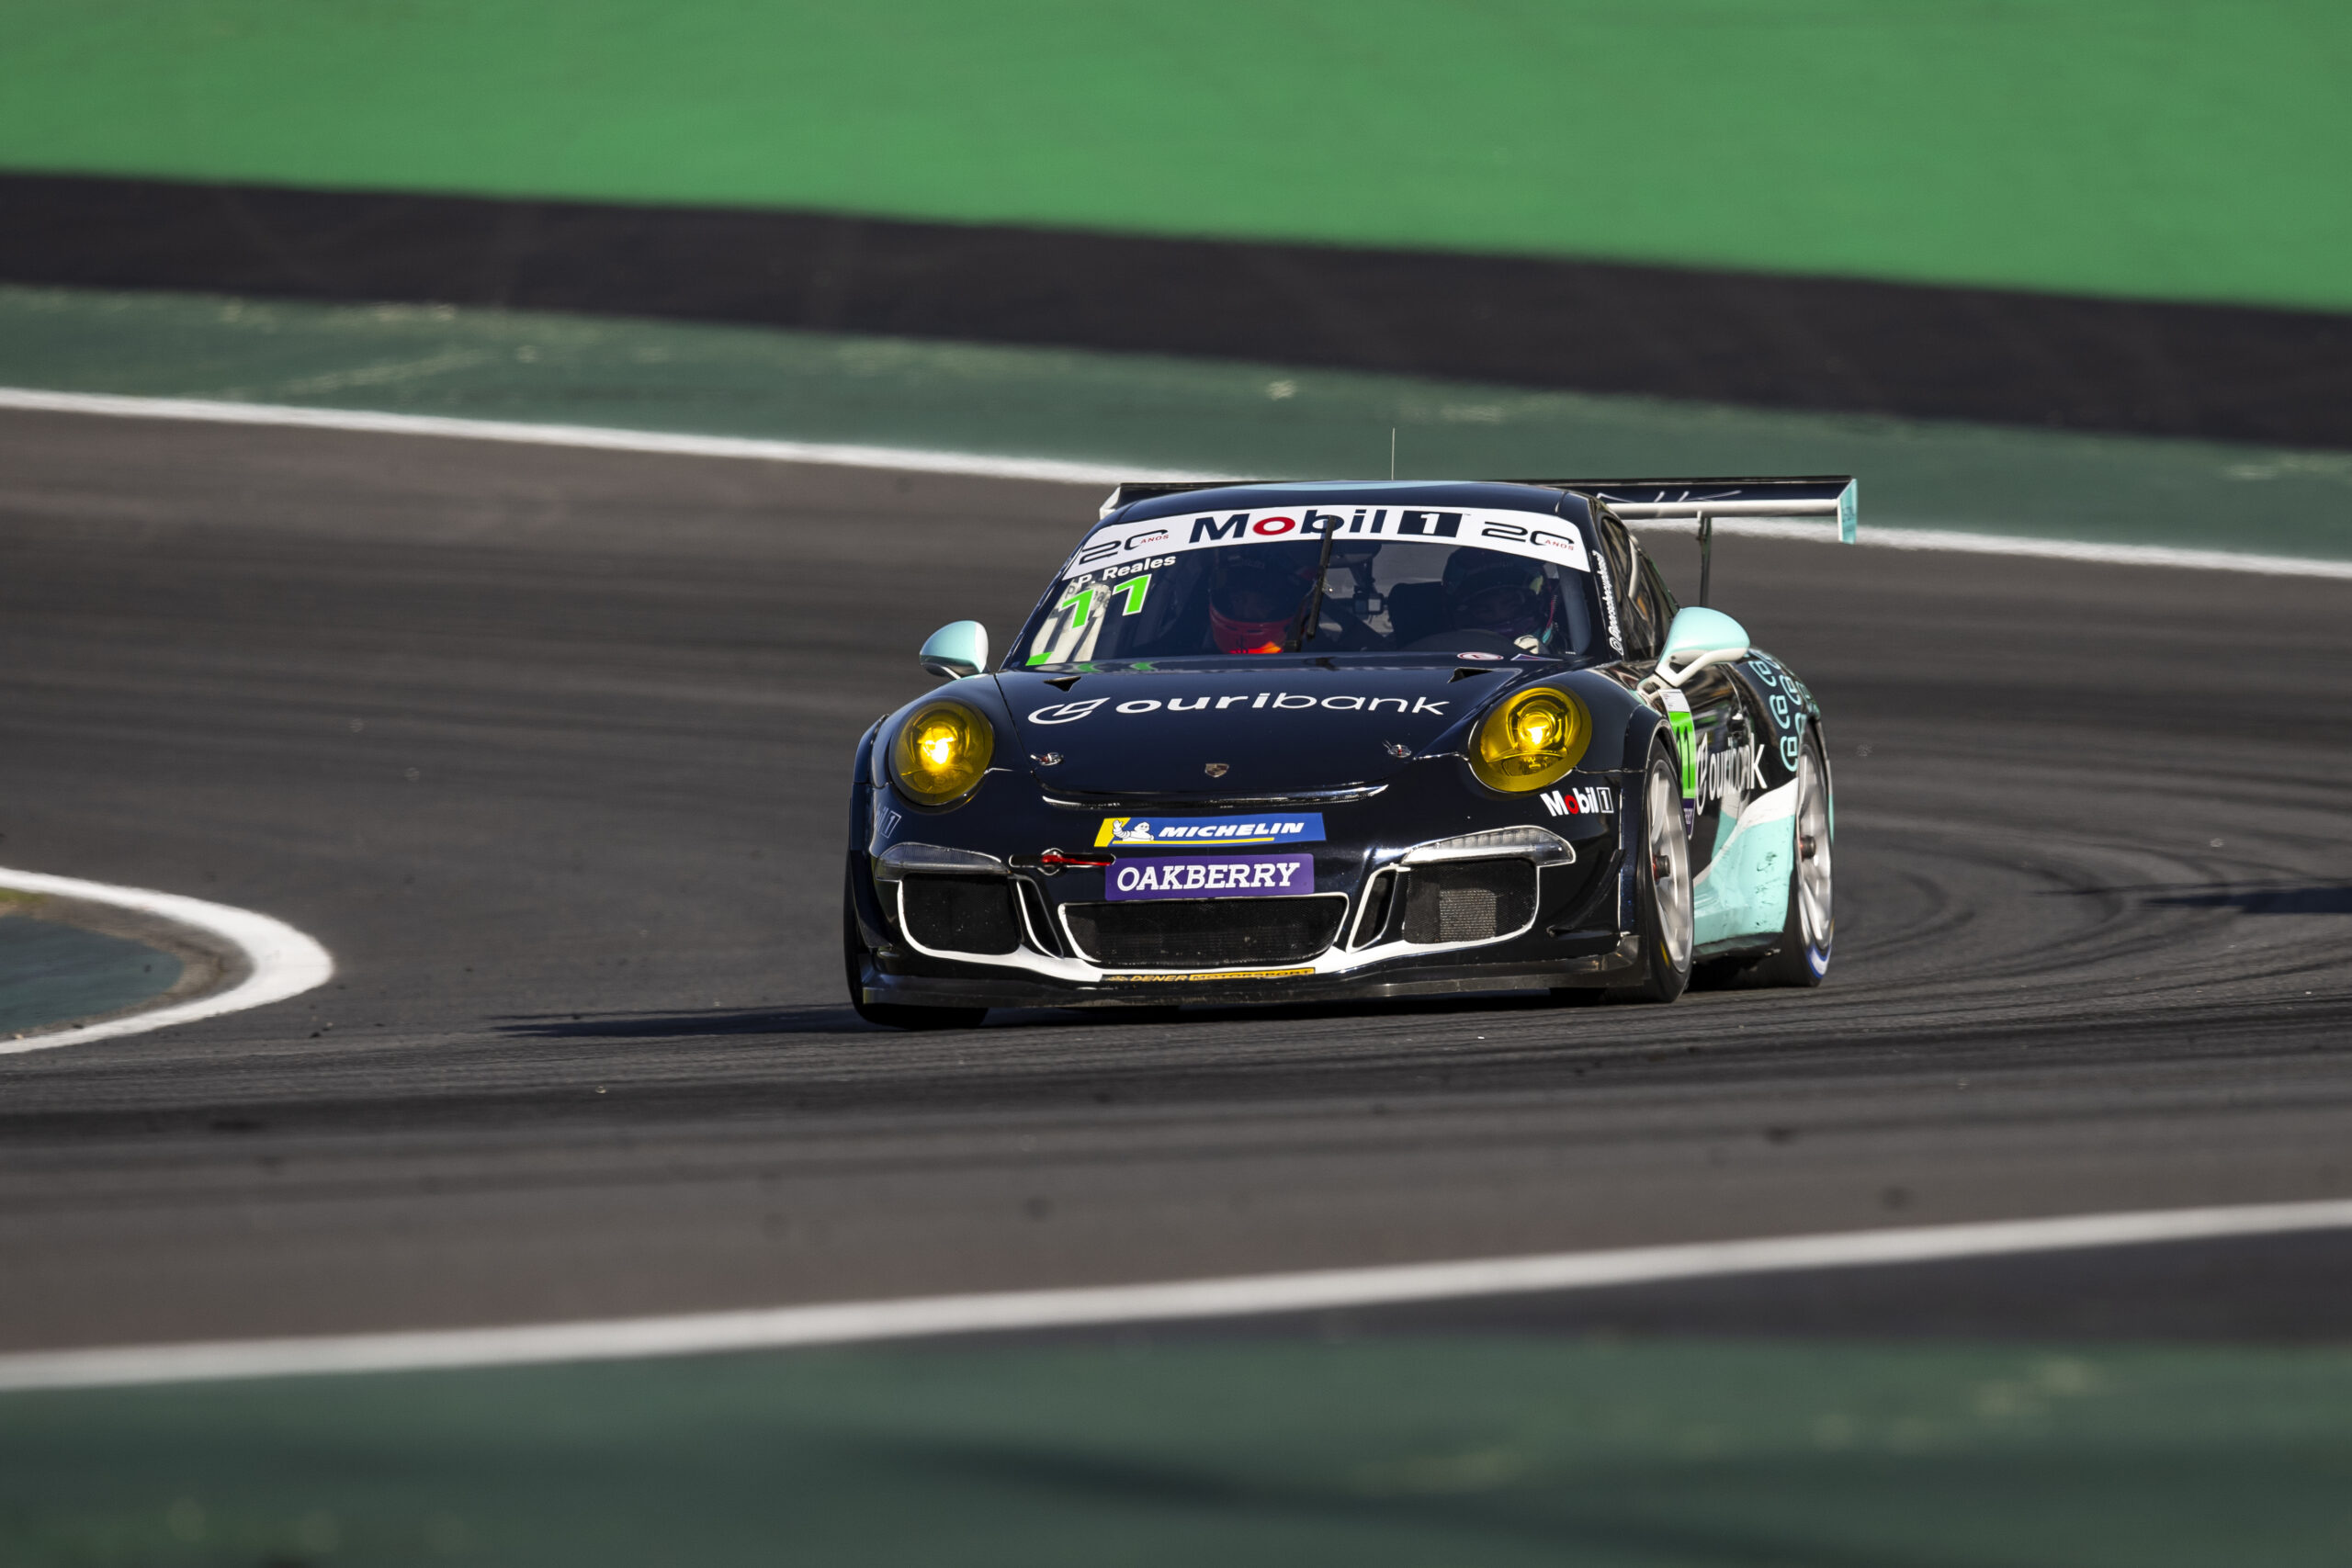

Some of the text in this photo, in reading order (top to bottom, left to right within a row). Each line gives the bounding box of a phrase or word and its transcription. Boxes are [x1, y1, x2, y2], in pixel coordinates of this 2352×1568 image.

[1140, 534, 1170, 545] ANOS
[1189, 509, 1387, 544] Mobil
[1544, 538, 1575, 551] ANOS
[1076, 555, 1177, 589] P. Reales
[1057, 573, 1153, 631] 11
[1115, 692, 1450, 716] ouribank
[1540, 786, 1600, 817] Mobil
[1158, 822, 1305, 838] MICHELIN
[1116, 862, 1301, 892] OAKBERRY
[1129, 974, 1187, 982] DENER
